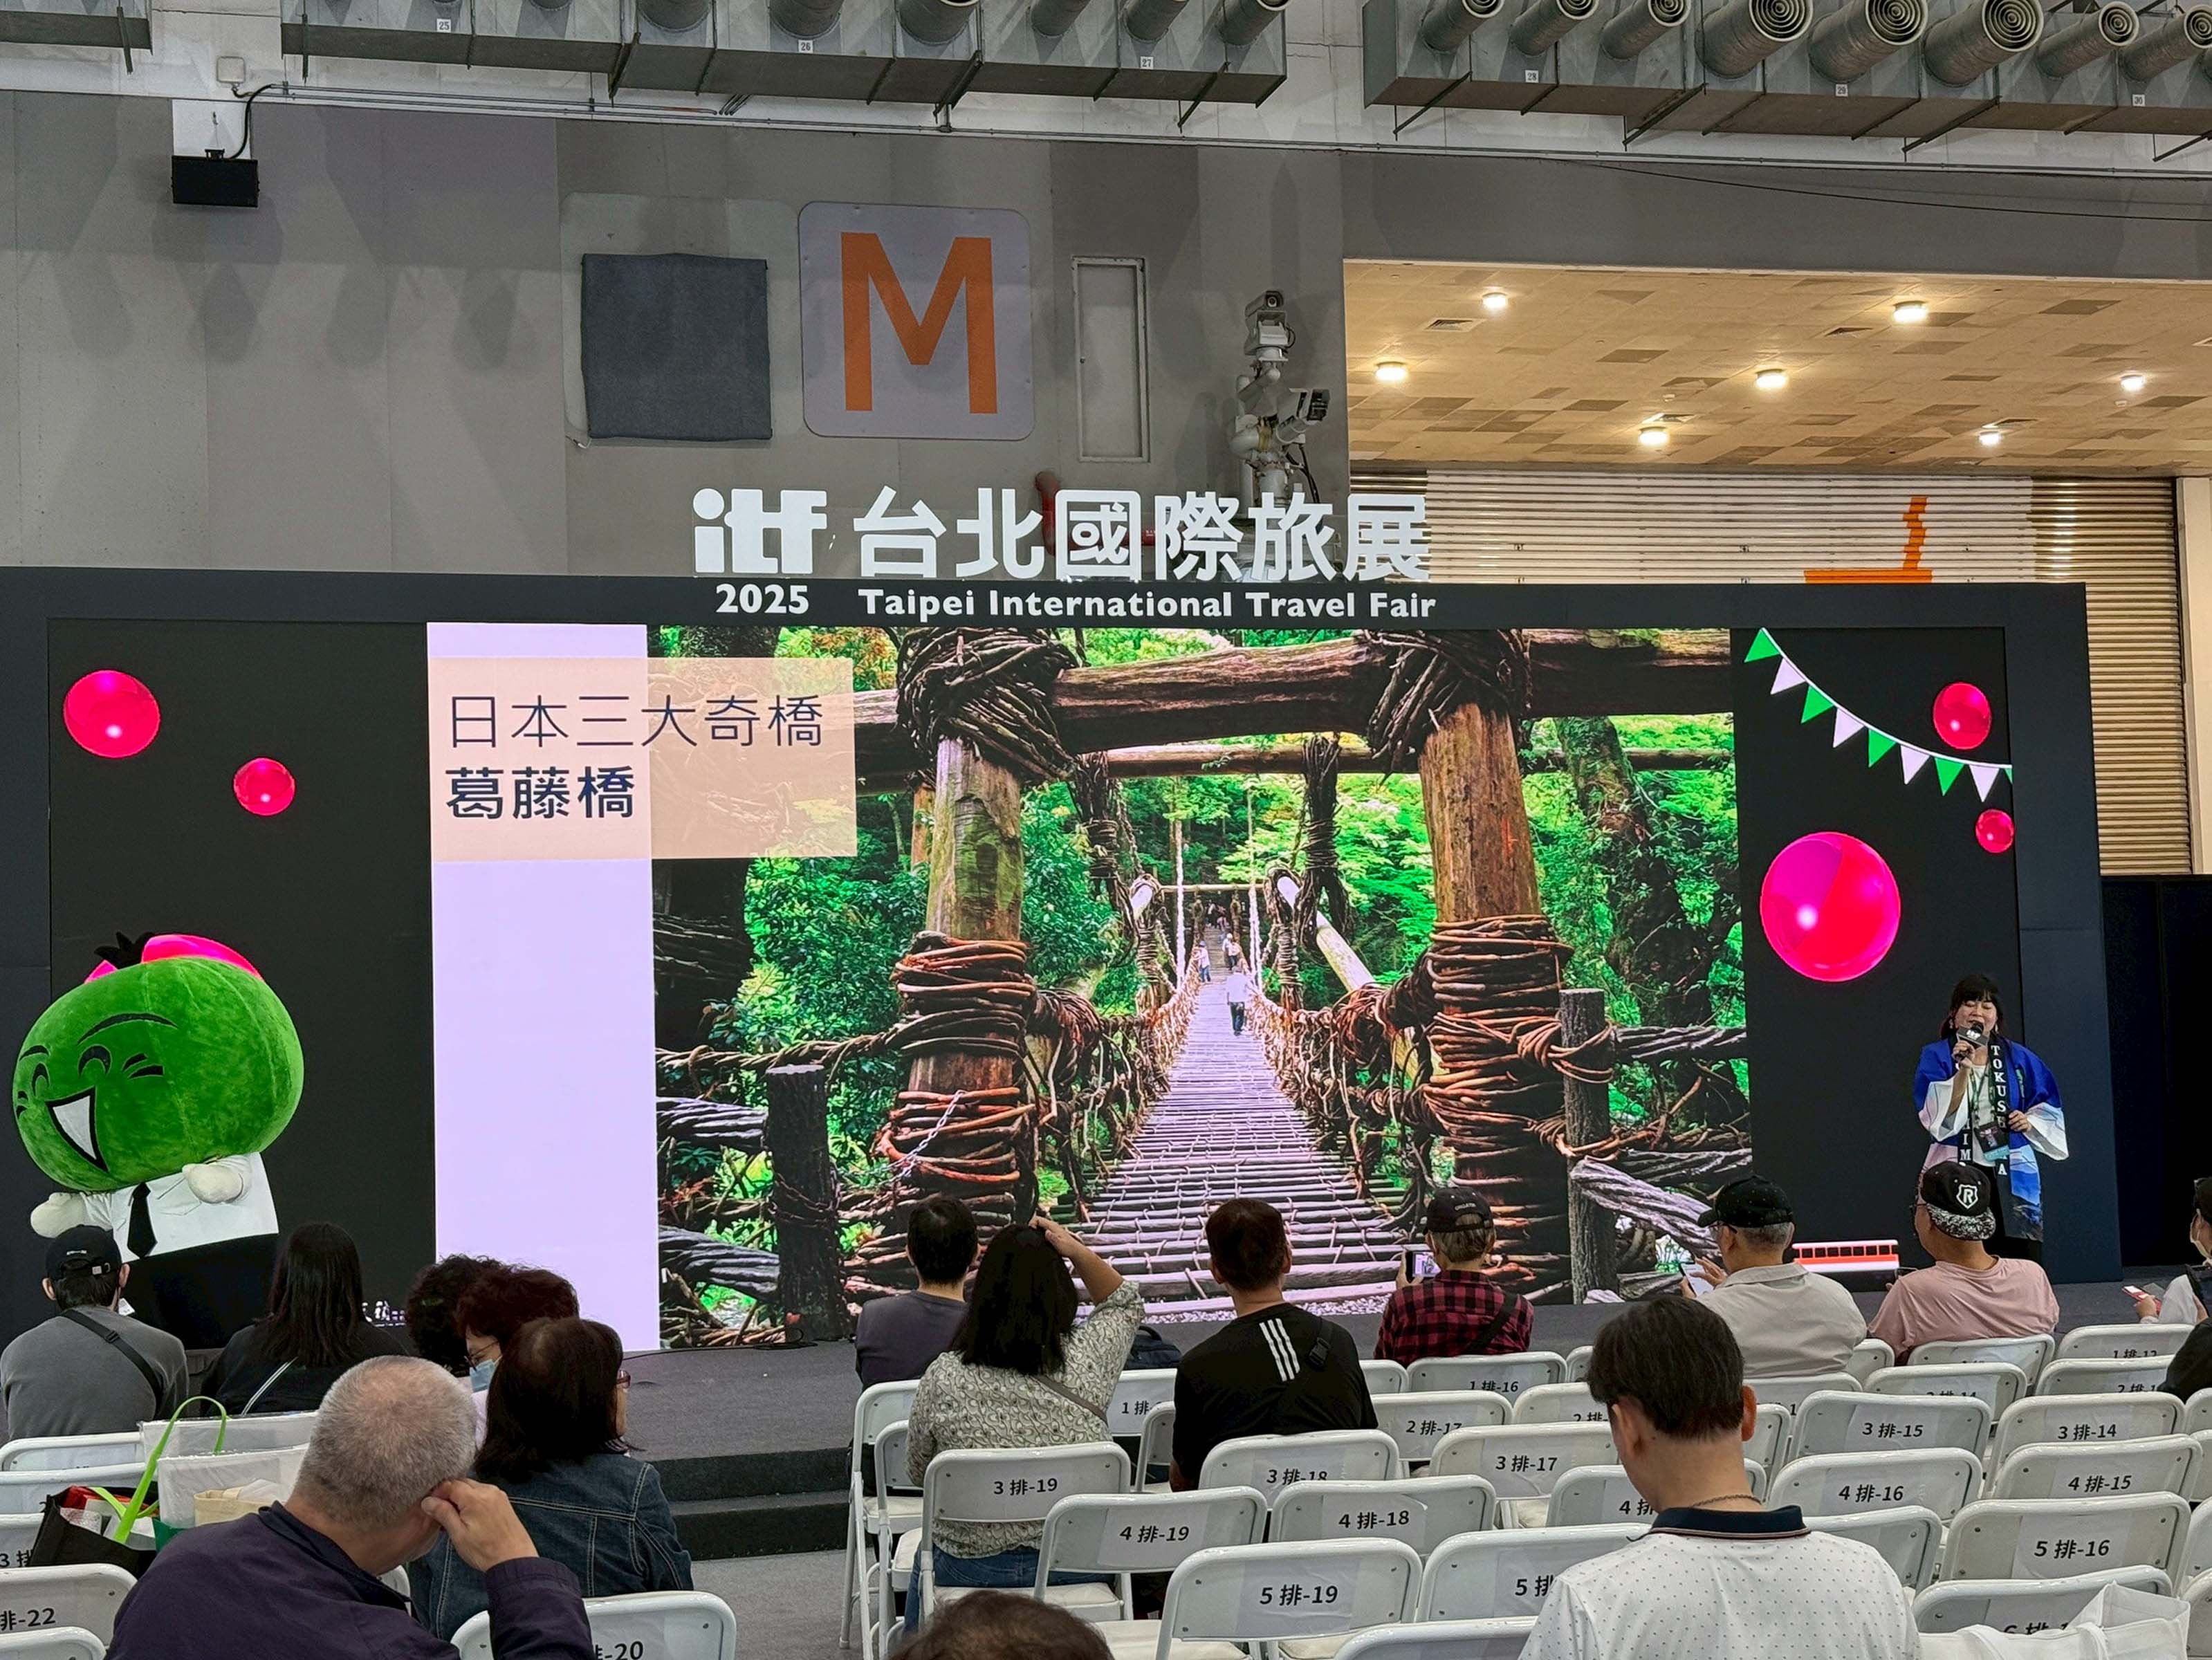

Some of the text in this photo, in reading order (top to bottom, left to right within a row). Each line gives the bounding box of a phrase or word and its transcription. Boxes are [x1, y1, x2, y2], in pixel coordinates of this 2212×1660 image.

[439, 21, 450, 30] 25
[800, 42, 811, 50] 26
[1142, 58, 1152, 67] 27
[841, 232, 997, 414] M
[854, 486, 1430, 582] 台北國際旅展
[716, 584, 1436, 622] 2025 Taipei International Travel Fair
[452, 694, 823, 748] 日本三大奇橋
[445, 766, 634, 820] 葛藤橋
[1963, 1189, 1973, 1204] R
